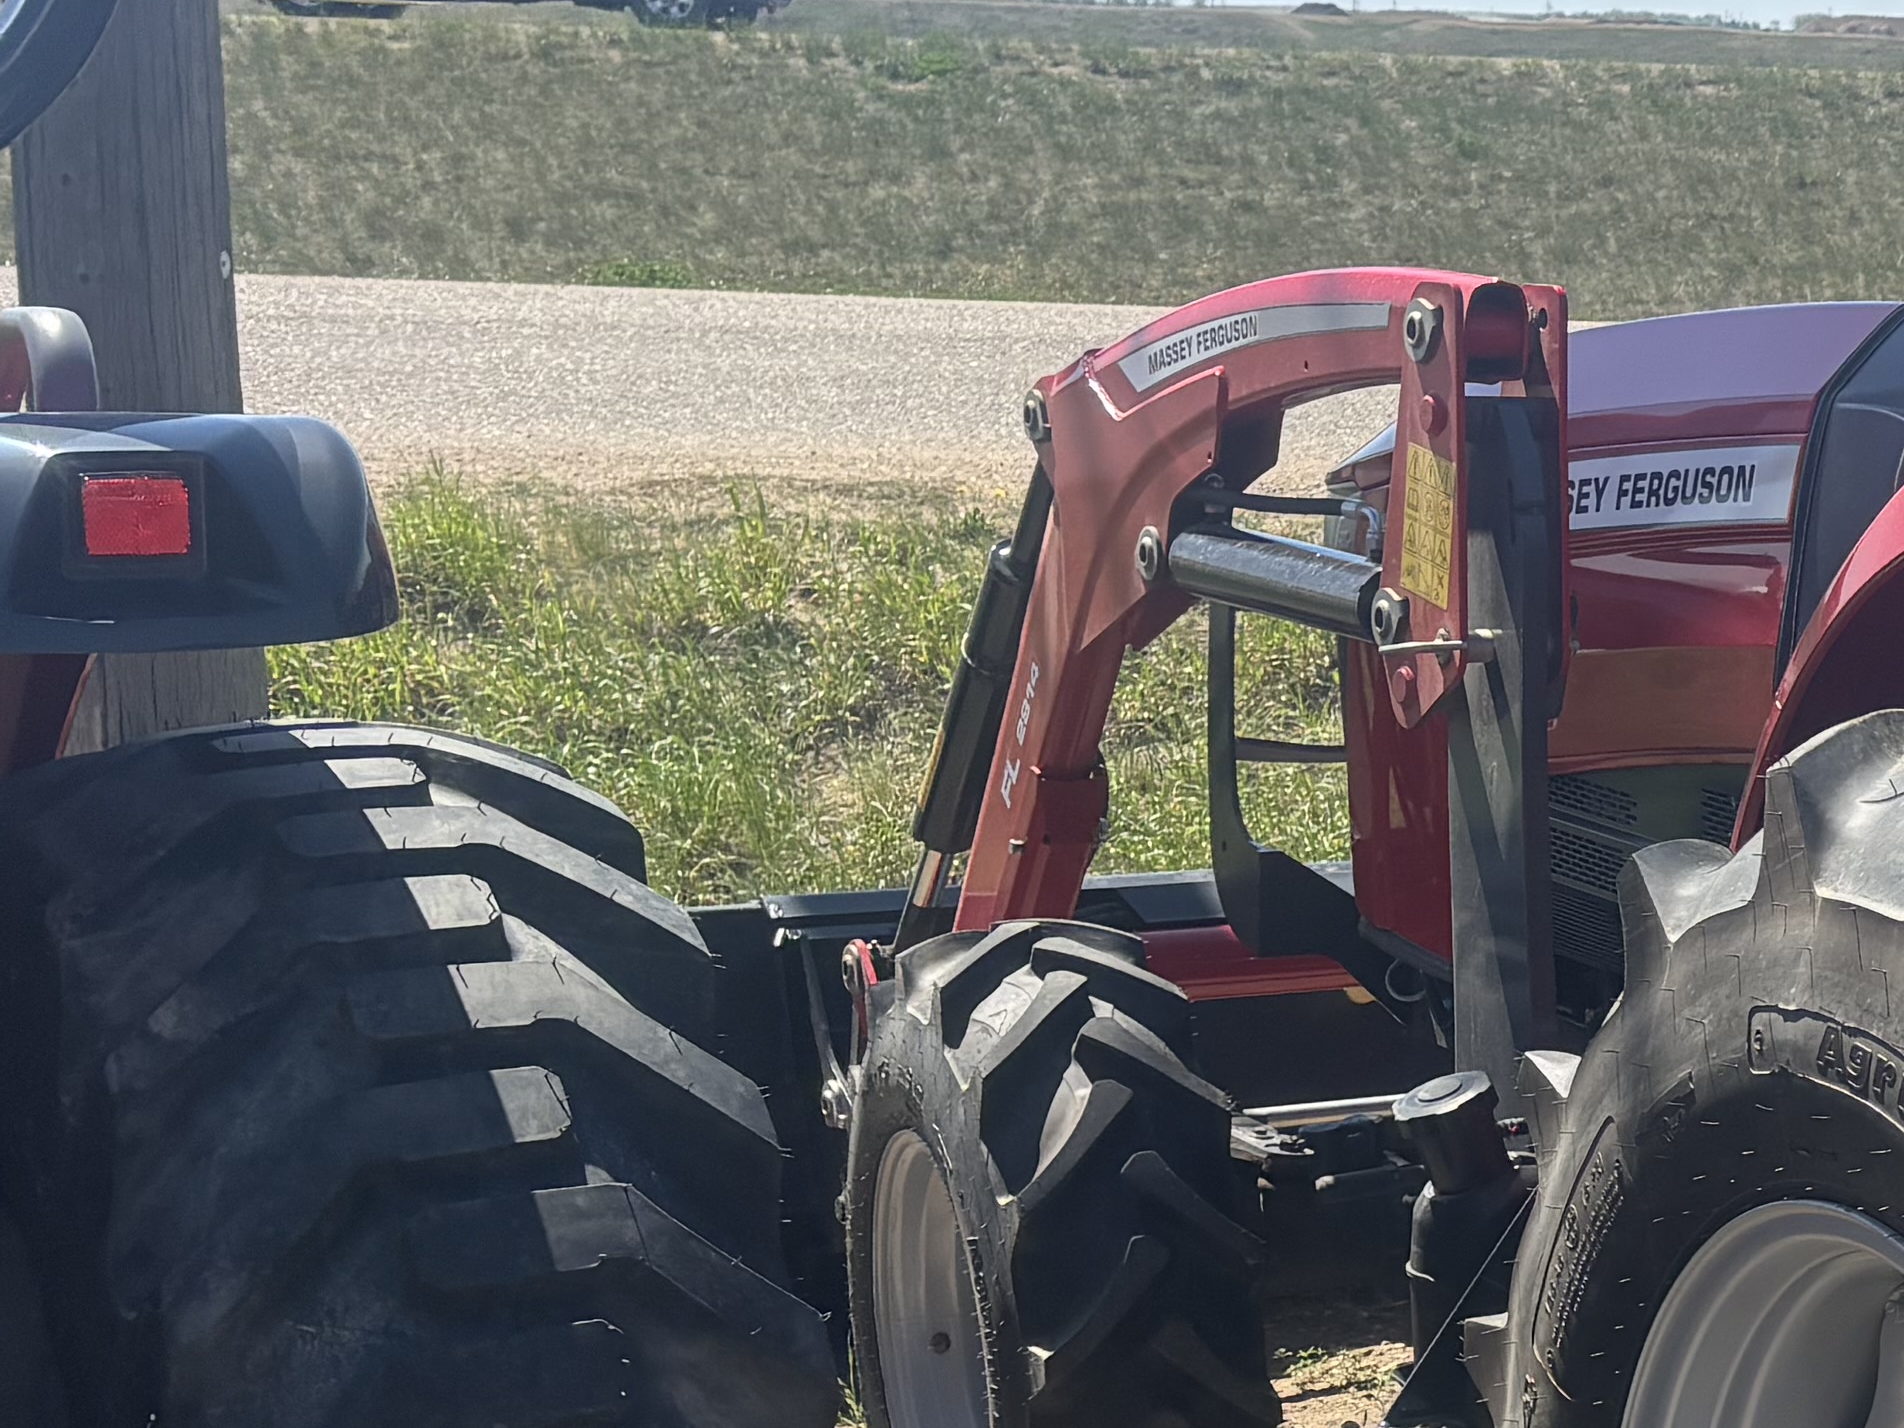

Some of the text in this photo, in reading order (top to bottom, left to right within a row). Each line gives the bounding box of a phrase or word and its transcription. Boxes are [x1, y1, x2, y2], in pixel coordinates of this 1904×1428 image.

[1147, 315, 1258, 375] MASSEY FERGUSON
[1616, 464, 1756, 511] FERGUSON
[1000, 758, 1021, 810] FL
